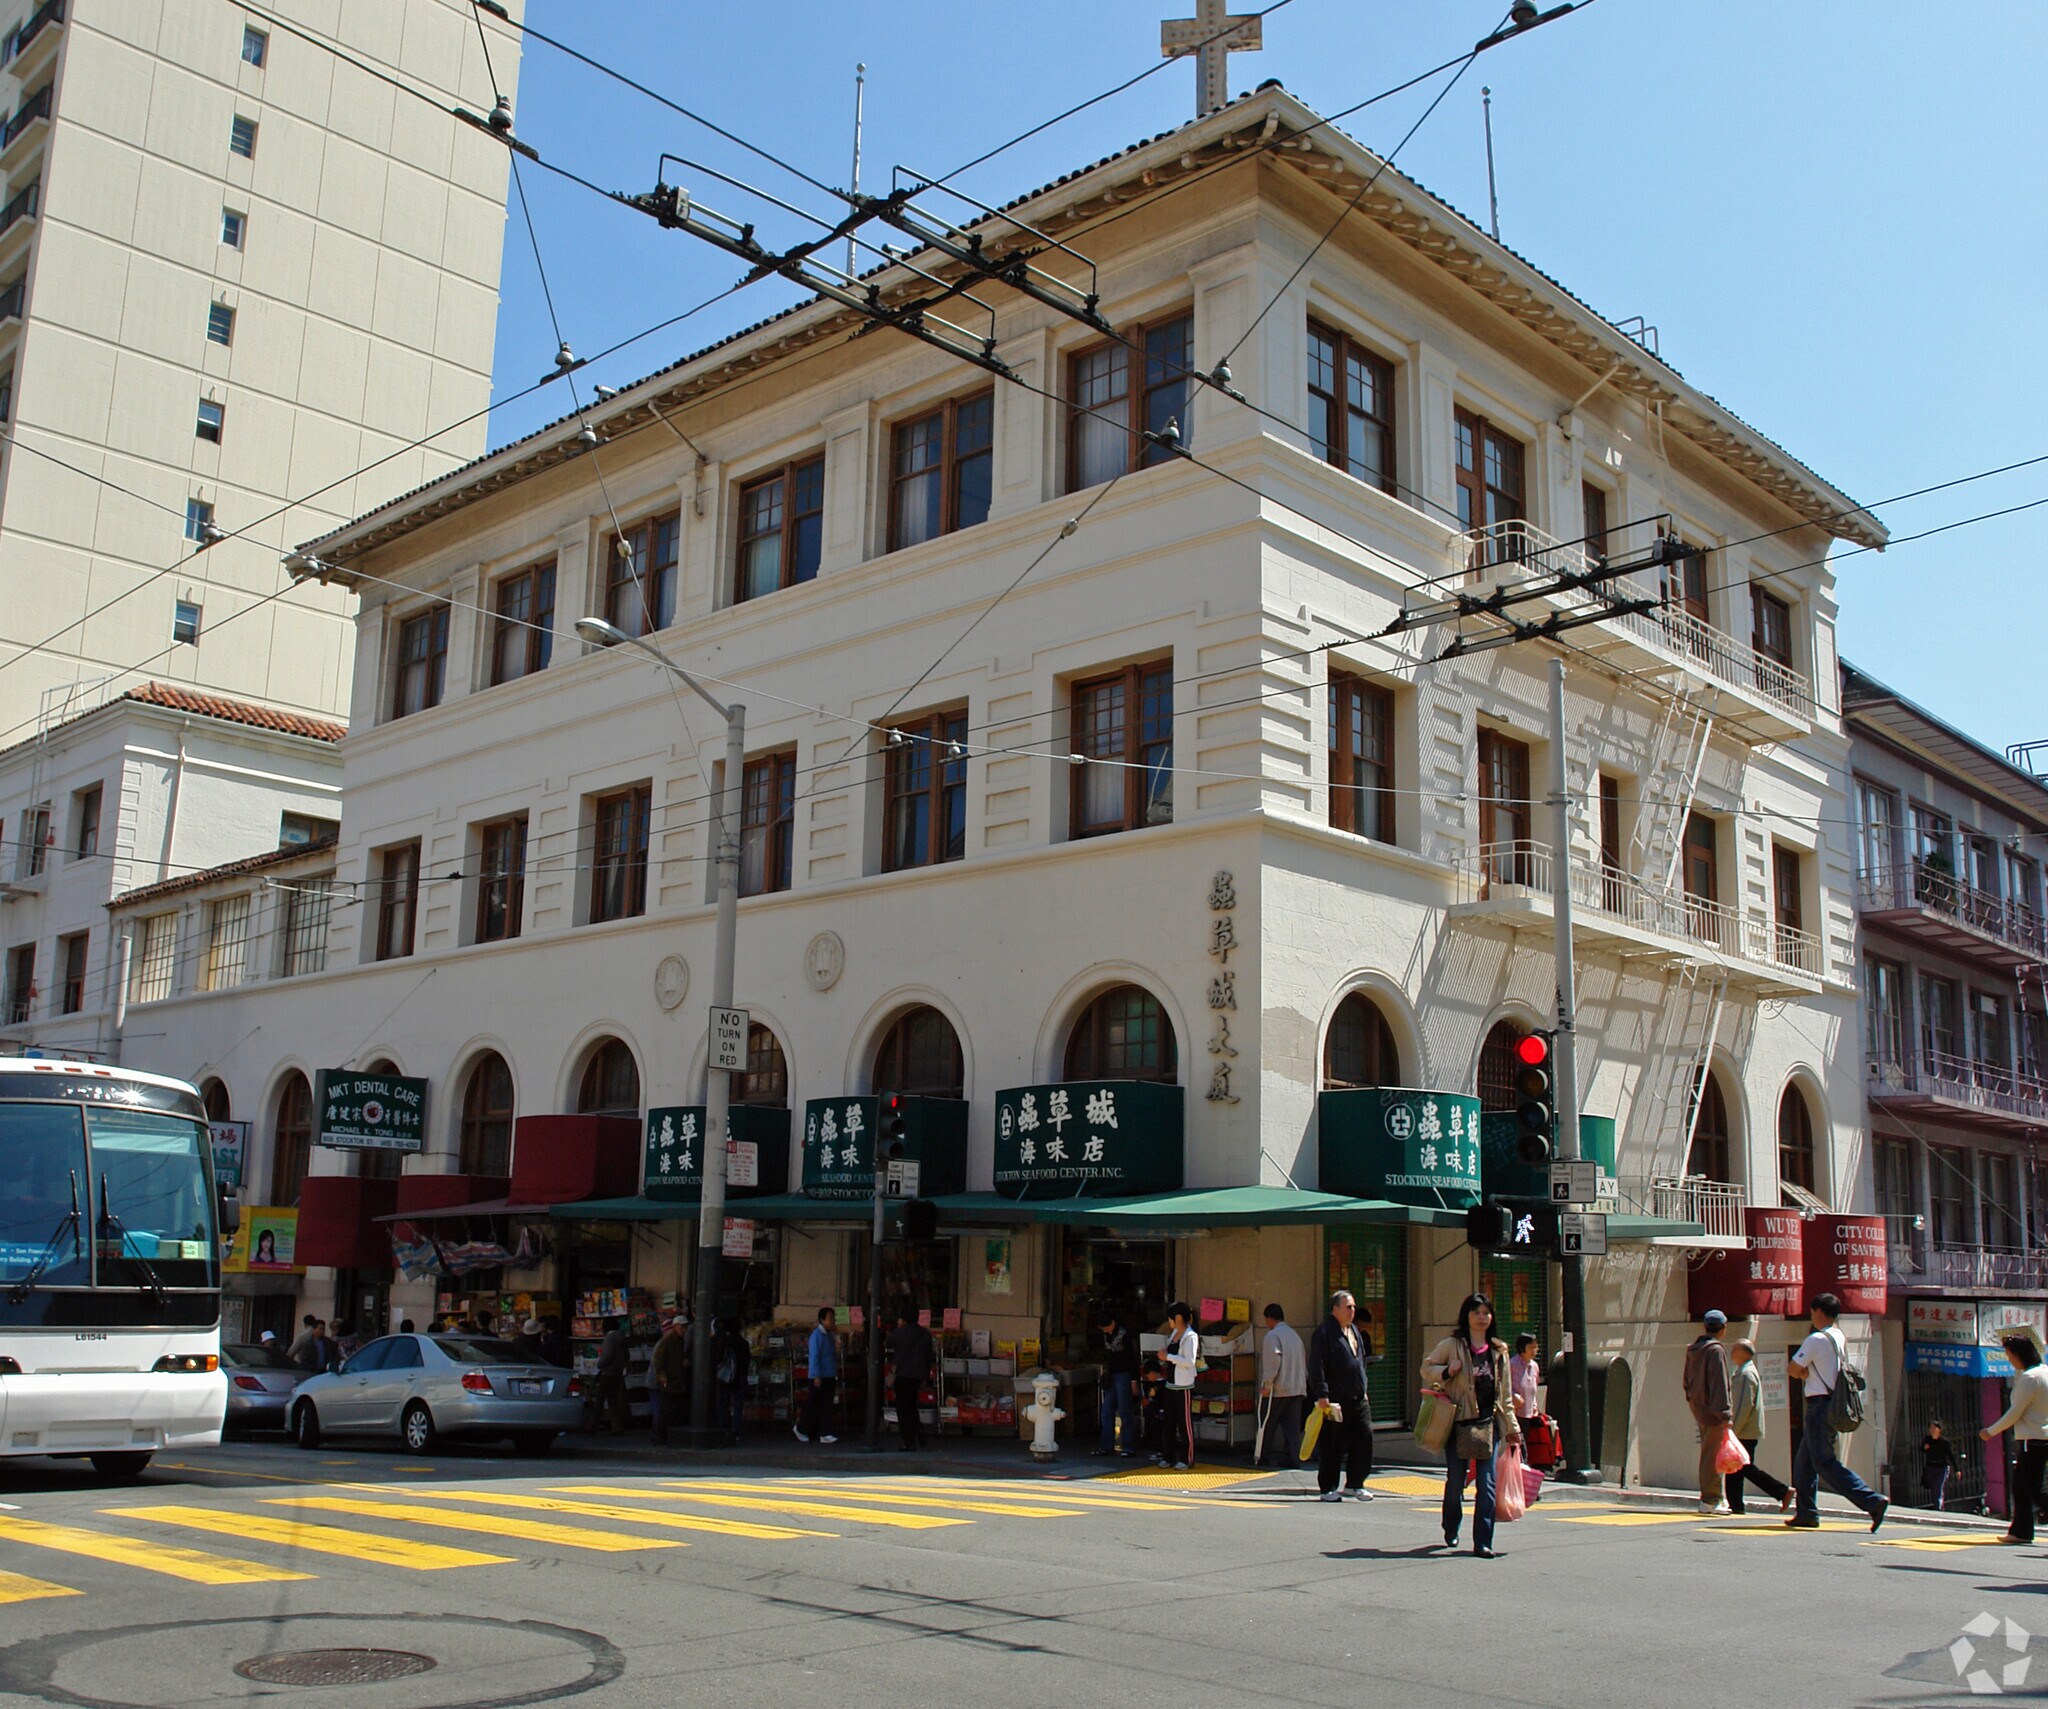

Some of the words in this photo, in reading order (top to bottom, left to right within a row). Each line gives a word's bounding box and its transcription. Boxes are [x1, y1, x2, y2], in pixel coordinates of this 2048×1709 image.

[720, 1013, 740, 1026] NO
[718, 1028, 740, 1039] TURN
[722, 1042, 735, 1052] ON
[720, 1054, 737, 1065] RED
[328, 1083, 349, 1100] MKT
[354, 1081, 390, 1096] DENTAL
[394, 1087, 420, 1106] CARE
[331, 1125, 361, 1135] MICHAEL
[375, 1129, 394, 1138] TONG
[821, 1144, 859, 1169] 海味
[1020, 1135, 1105, 1165] 海味店
[1021, 1168, 1057, 1181] SEAFOOD
[1385, 1174, 1431, 1186] STOCKTON
[1432, 1175, 1462, 1187] SEAFOOD
[1597, 1181, 1615, 1194] AY
[1765, 1217, 1784, 1234] WU
[1785, 1219, 1798, 1236] YEE
[1836, 1225, 1864, 1239] CITY
[1834, 1242, 1849, 1255] OF
[1851, 1243, 1869, 1256] SAN
[1917, 1347, 1972, 1360] MASSAGE
